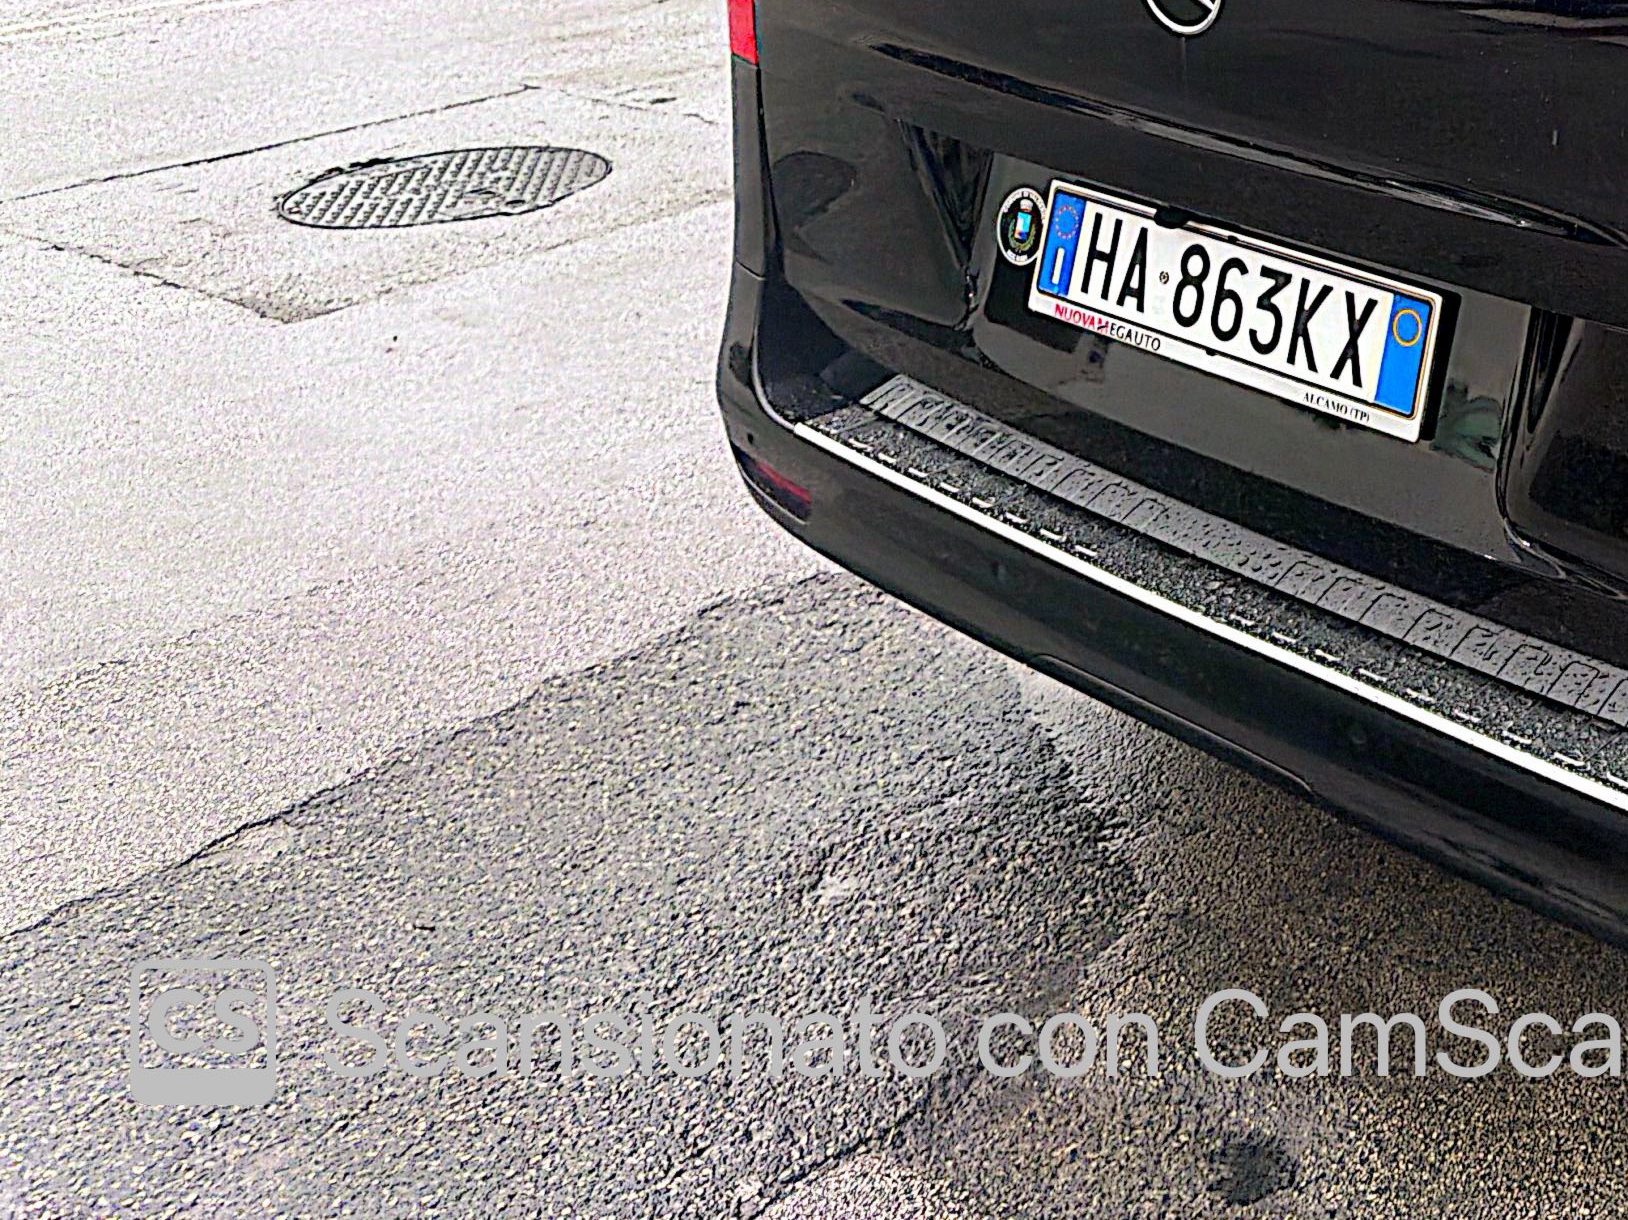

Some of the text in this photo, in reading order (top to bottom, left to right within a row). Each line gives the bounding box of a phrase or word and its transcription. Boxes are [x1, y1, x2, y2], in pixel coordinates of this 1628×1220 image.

[1081, 212, 1149, 314] HA
[1172, 243, 1379, 388] 863KX
[1303, 392, 1370, 423] ALCAMO (TP)
